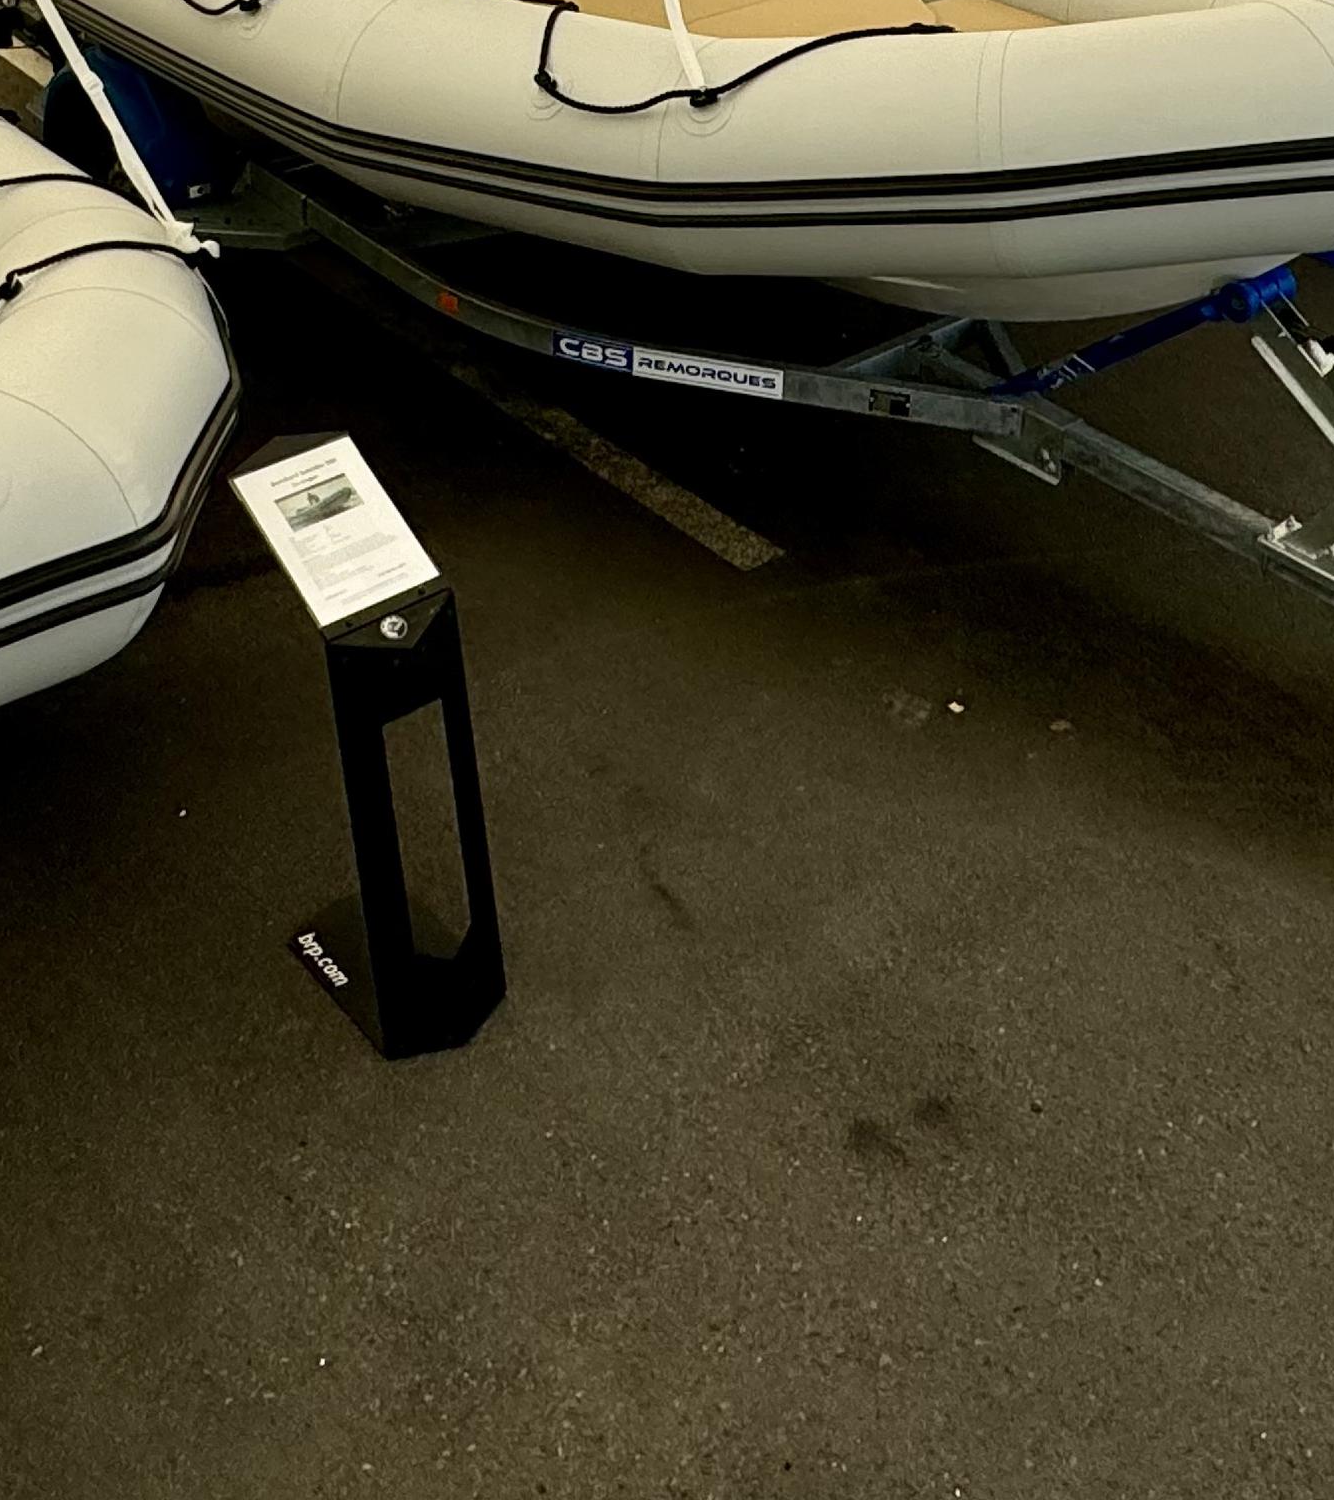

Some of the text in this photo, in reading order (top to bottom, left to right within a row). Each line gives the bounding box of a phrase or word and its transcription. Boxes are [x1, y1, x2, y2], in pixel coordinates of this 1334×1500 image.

[558, 336, 777, 390] CBS REMORQUES
[297, 931, 350, 988] brp.com
